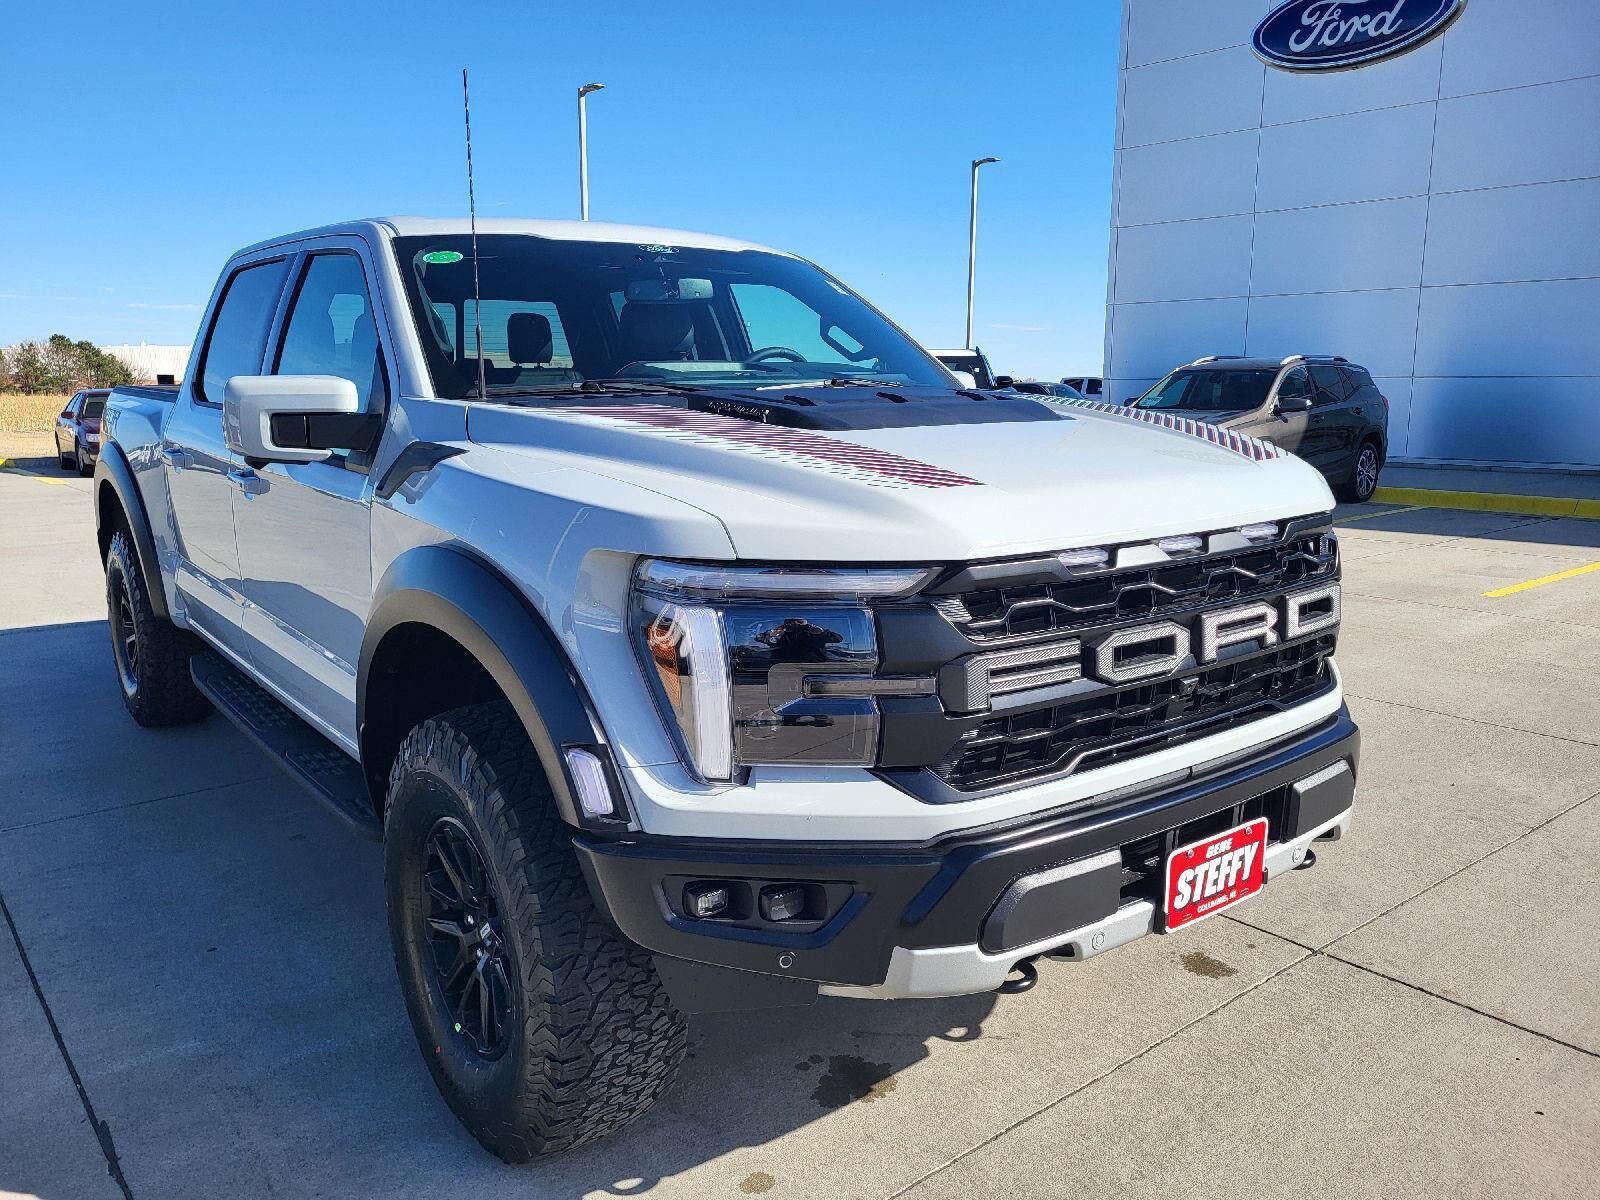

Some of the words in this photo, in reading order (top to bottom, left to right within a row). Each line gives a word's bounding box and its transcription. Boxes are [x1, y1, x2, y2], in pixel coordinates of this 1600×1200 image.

[1288, 0, 1405, 53] Ford
[965, 581, 1342, 710] FORD
[1173, 841, 1260, 909] STEFFY
